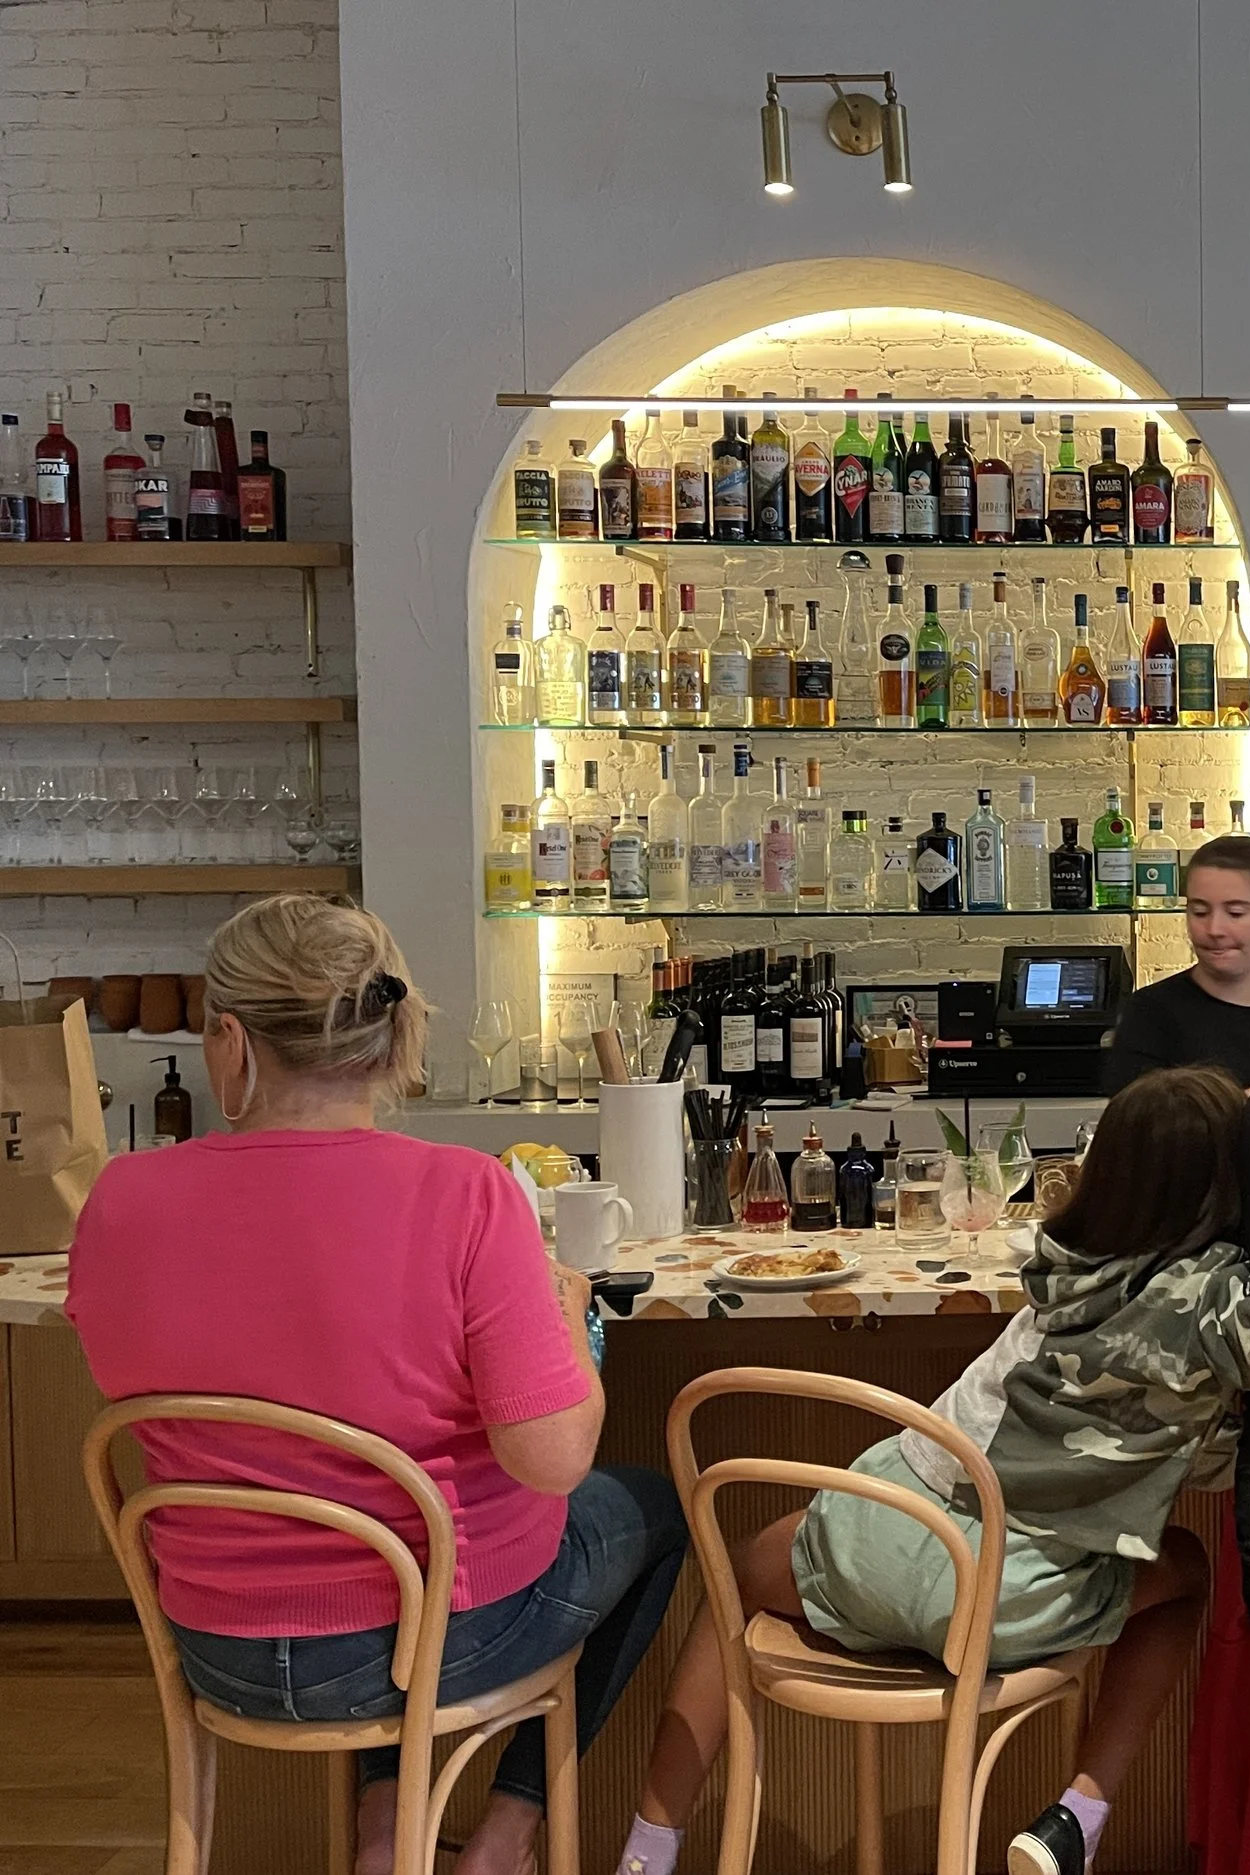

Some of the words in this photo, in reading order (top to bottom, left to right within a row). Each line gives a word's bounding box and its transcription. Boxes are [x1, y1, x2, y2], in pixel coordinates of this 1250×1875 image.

[795, 464, 829, 475] AVERNA
[834, 469, 868, 497] CYNAR
[1135, 502, 1165, 510] AMARA
[548, 982, 592, 991] MAXIMUM
